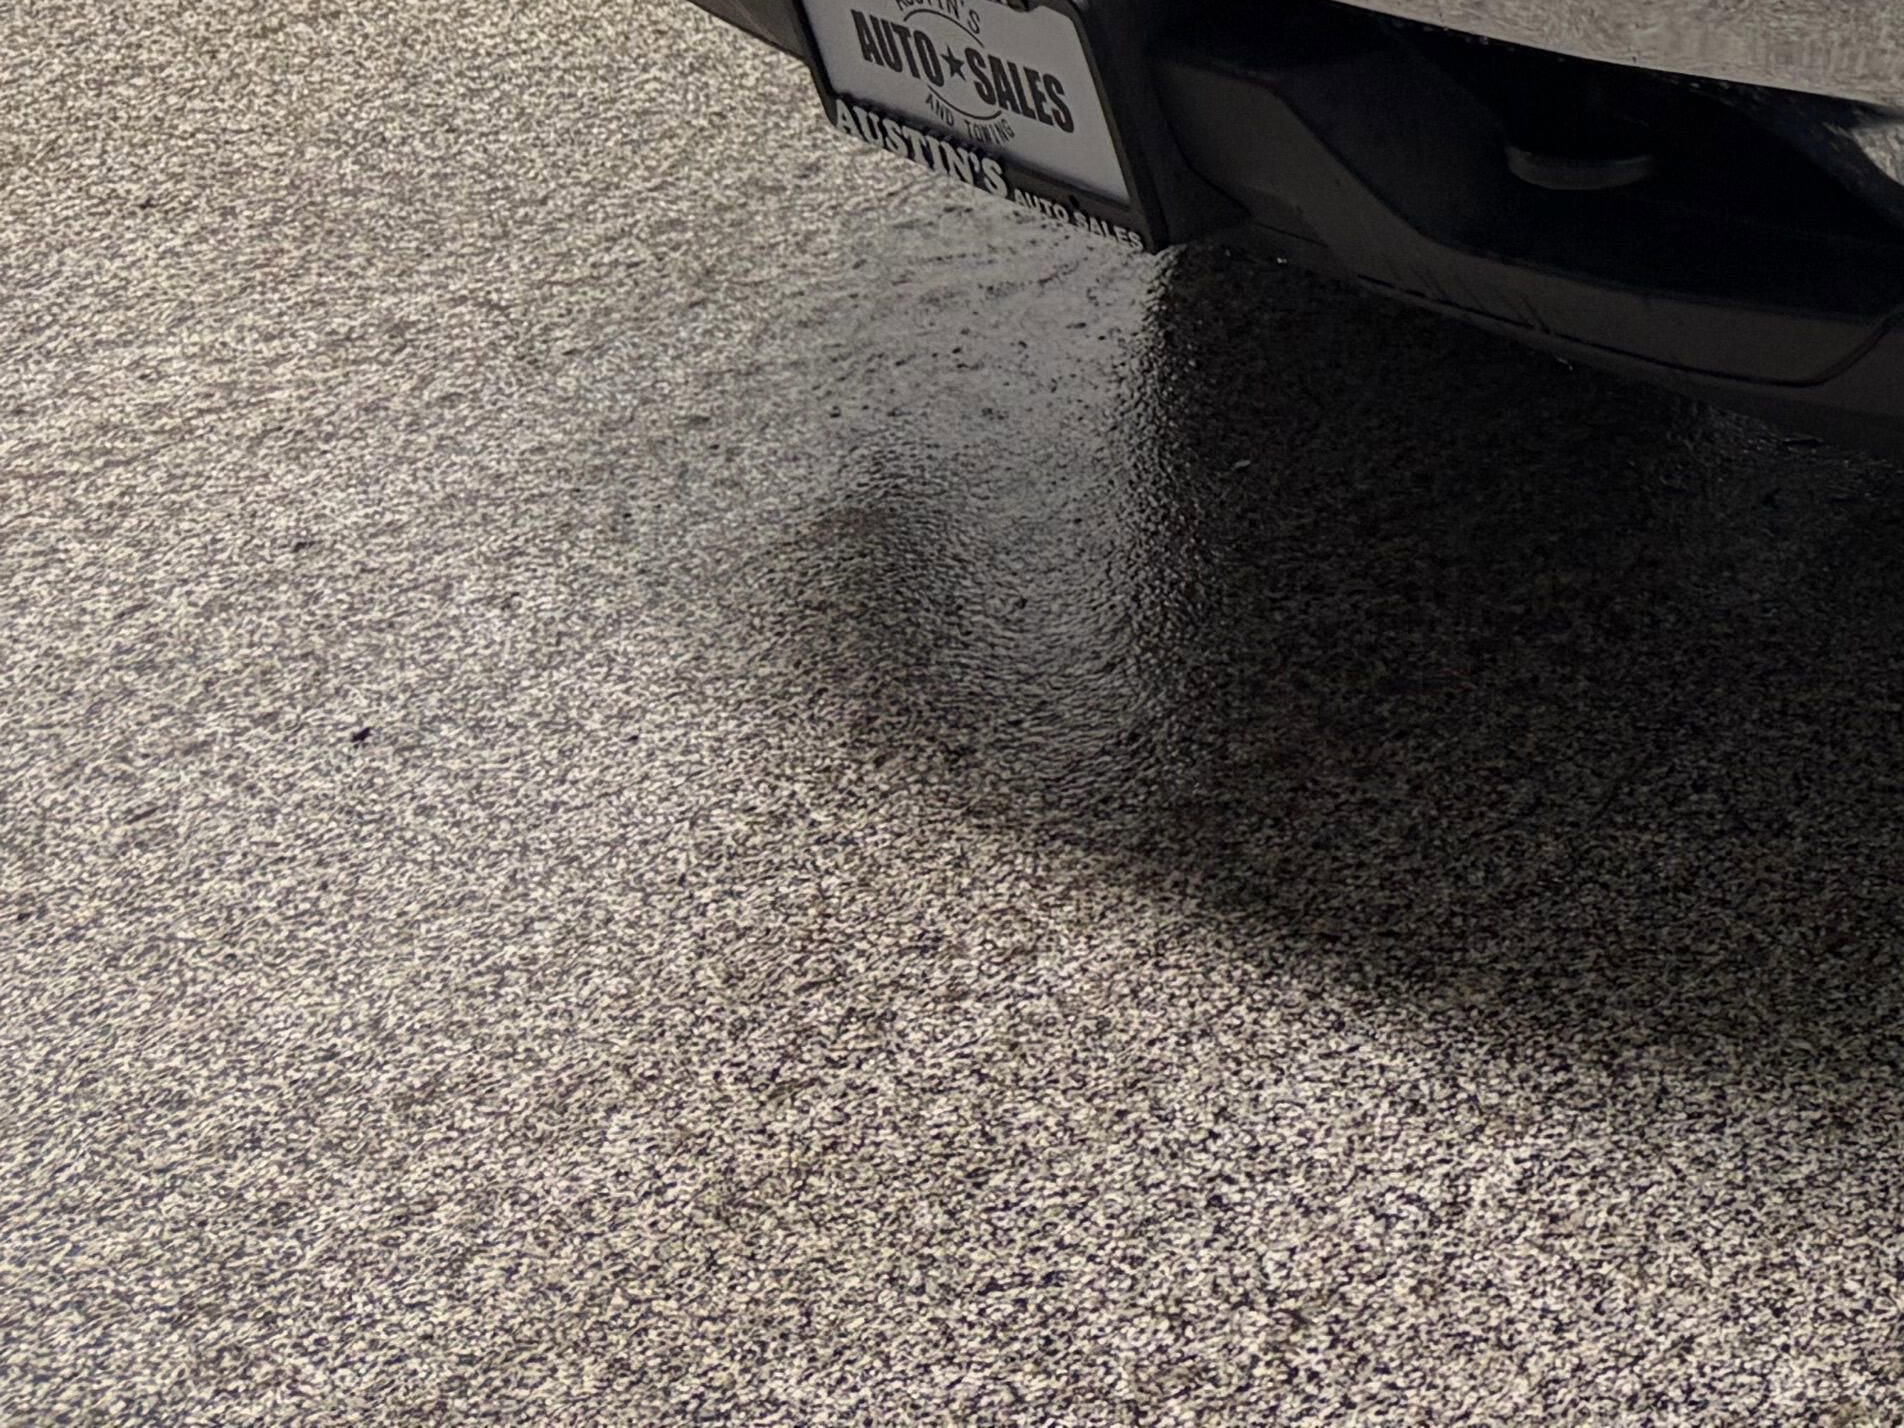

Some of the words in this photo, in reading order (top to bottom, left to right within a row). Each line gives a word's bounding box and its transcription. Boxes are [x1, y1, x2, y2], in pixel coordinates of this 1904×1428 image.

[851, 9, 944, 87] AUTO
[966, 47, 1075, 133] SALES
[834, 99, 1008, 199] AUSTIN'S
[1014, 190, 1069, 221] AUTO
[1072, 211, 1144, 250] SALES
